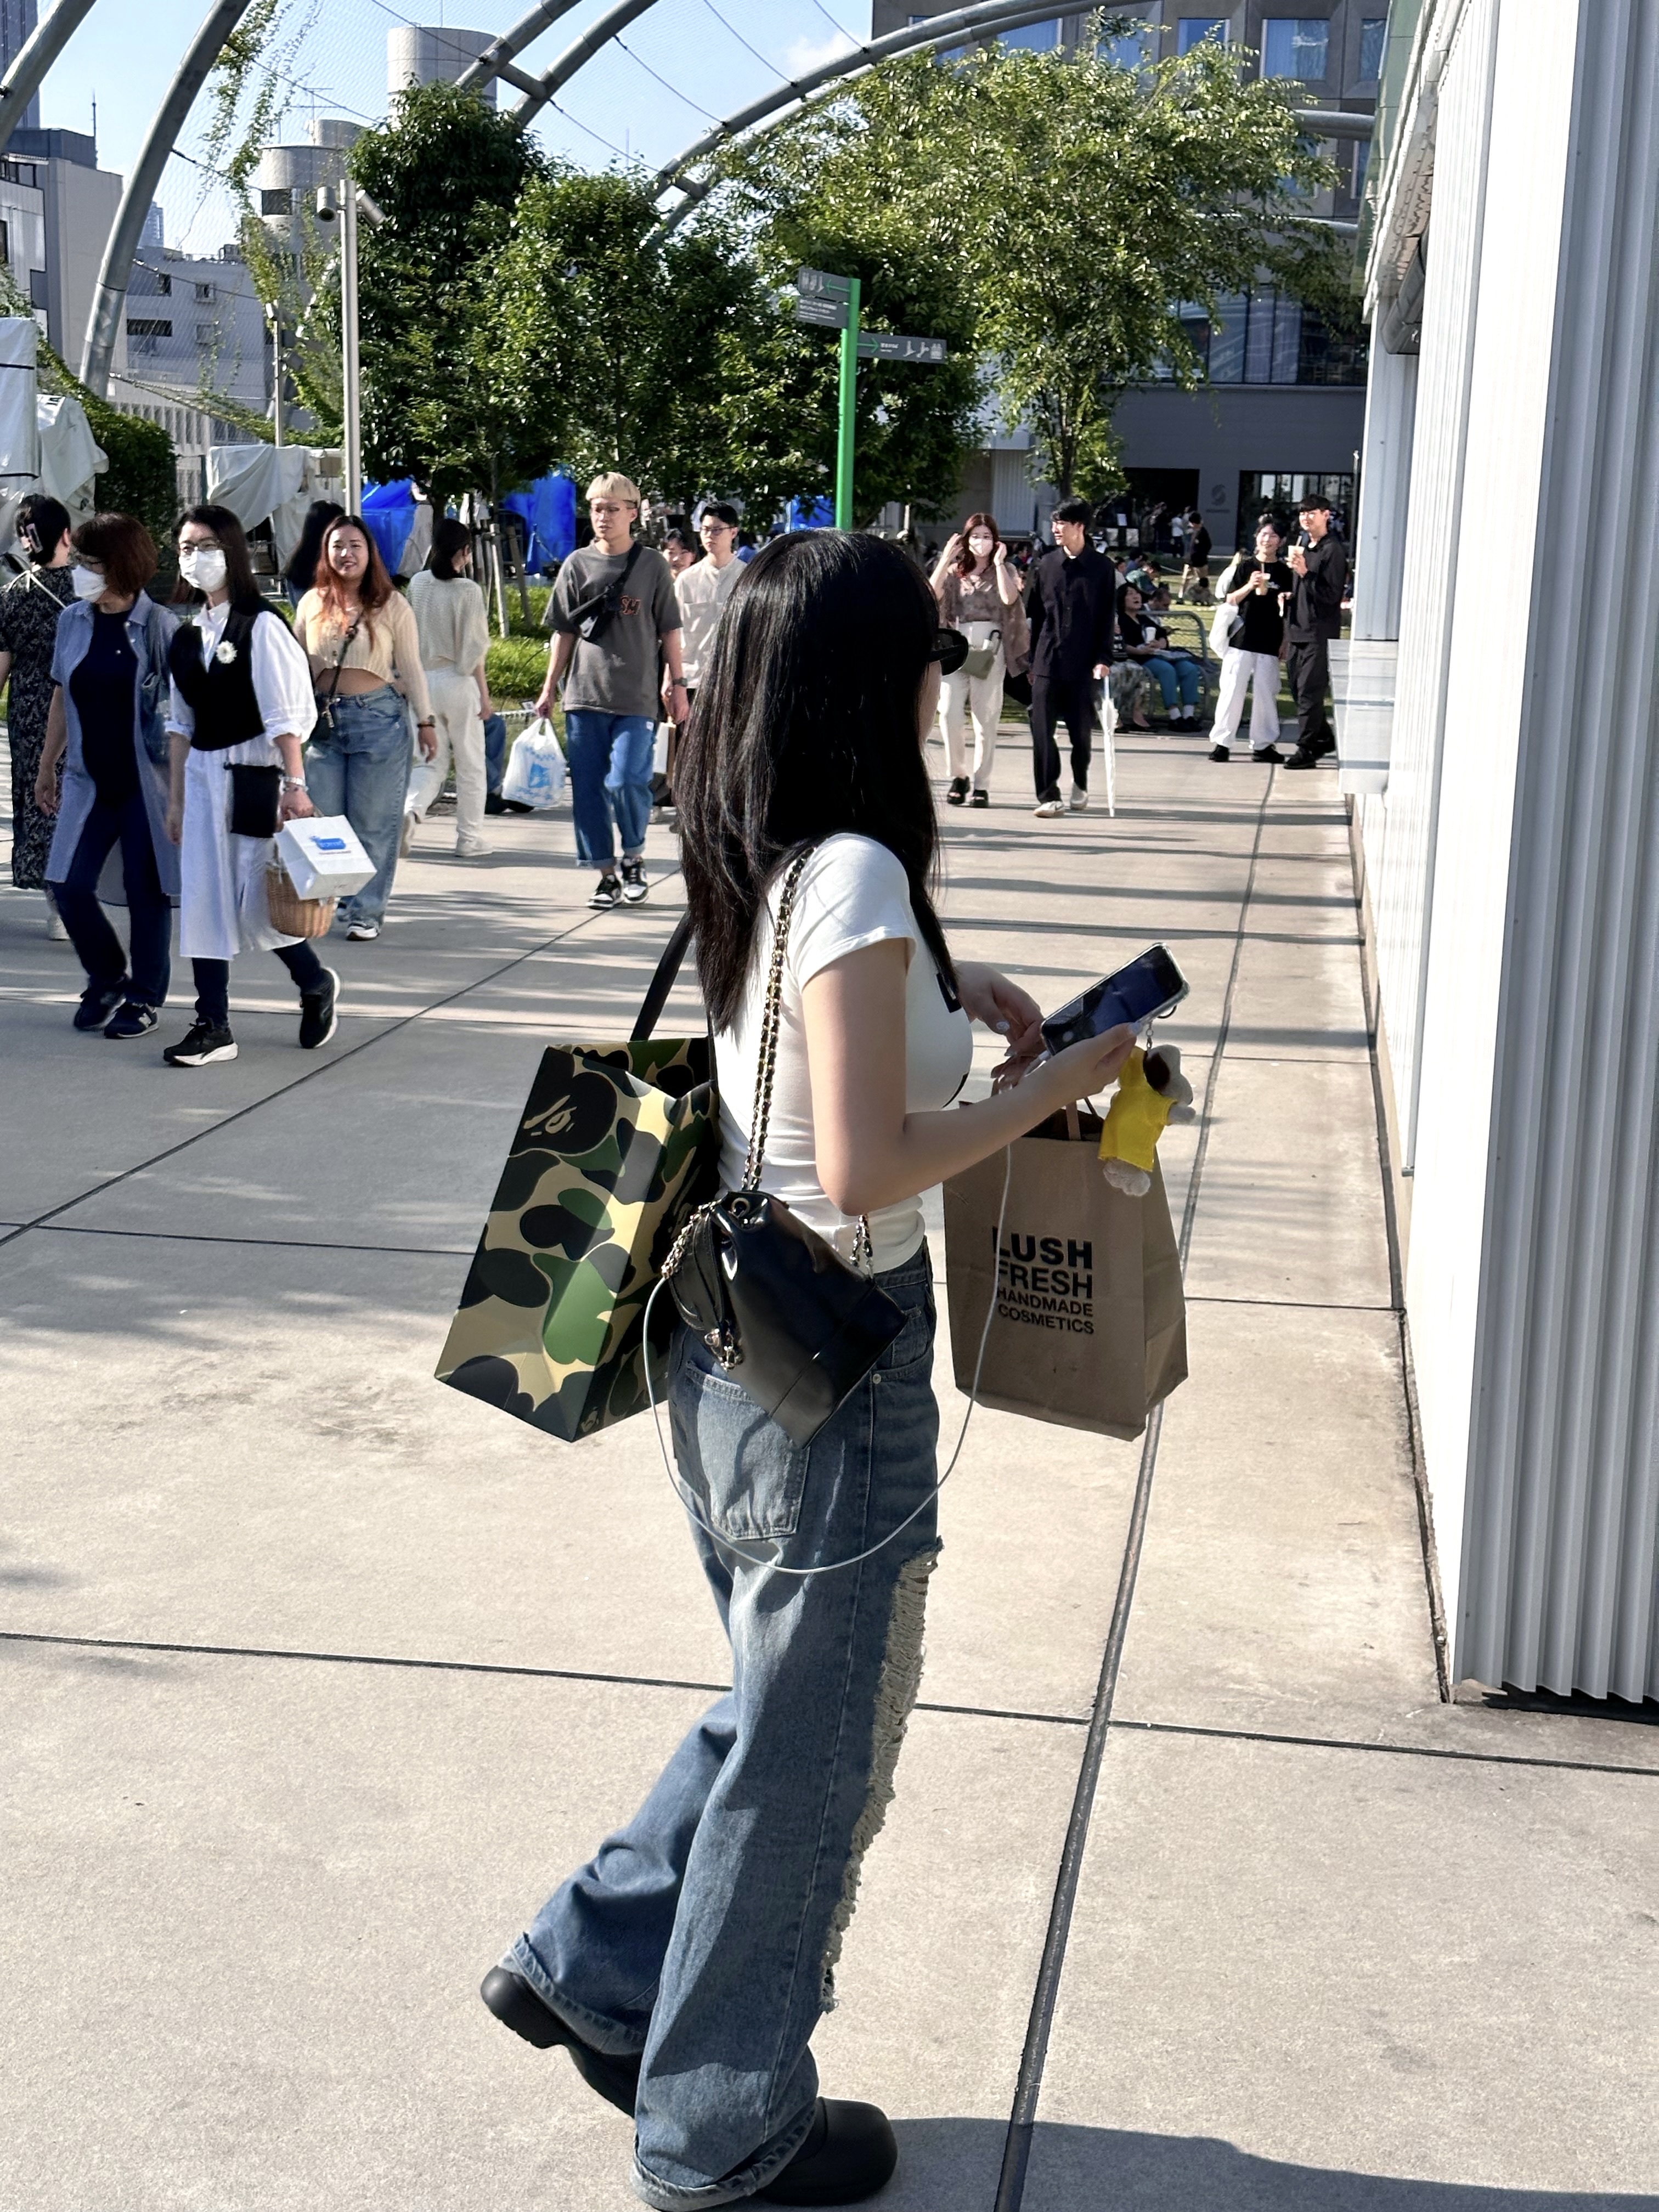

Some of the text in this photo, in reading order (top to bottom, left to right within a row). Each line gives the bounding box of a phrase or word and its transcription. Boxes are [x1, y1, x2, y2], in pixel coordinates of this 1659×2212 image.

[992, 1226, 1092, 1269] LUSH
[994, 1258, 1092, 1299] FRESH
[997, 1287, 1093, 1317] HANDMADE
[998, 1304, 1094, 1334] COSMETICS
